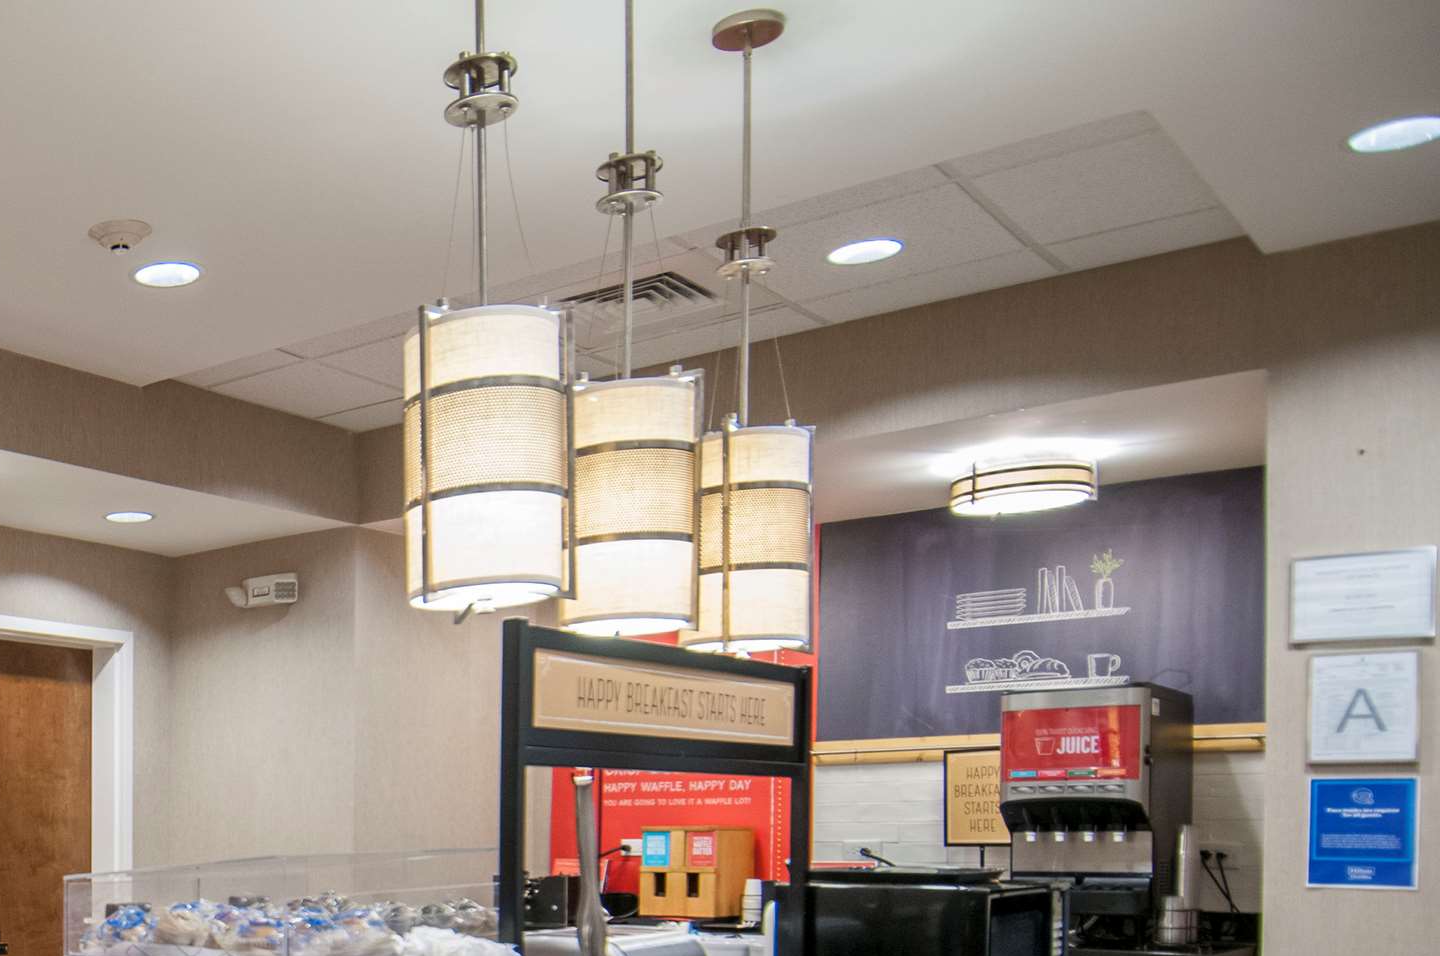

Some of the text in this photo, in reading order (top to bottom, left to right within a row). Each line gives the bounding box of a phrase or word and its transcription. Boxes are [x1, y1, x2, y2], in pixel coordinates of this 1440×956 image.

[576, 676, 767, 728] HAPPY BREAKFAST STARTS HERE
[1335, 687, 1388, 733] A
[1056, 735, 1100, 755] JUICE
[966, 766, 1001, 780] HAPPY
[604, 782, 637, 793] HAPPY
[688, 779, 726, 792] HAPPY
[729, 779, 752, 791] DAY
[954, 783, 1001, 799] BREAKFA
[963, 800, 1001, 816] STARTS
[970, 818, 997, 833] HERE
